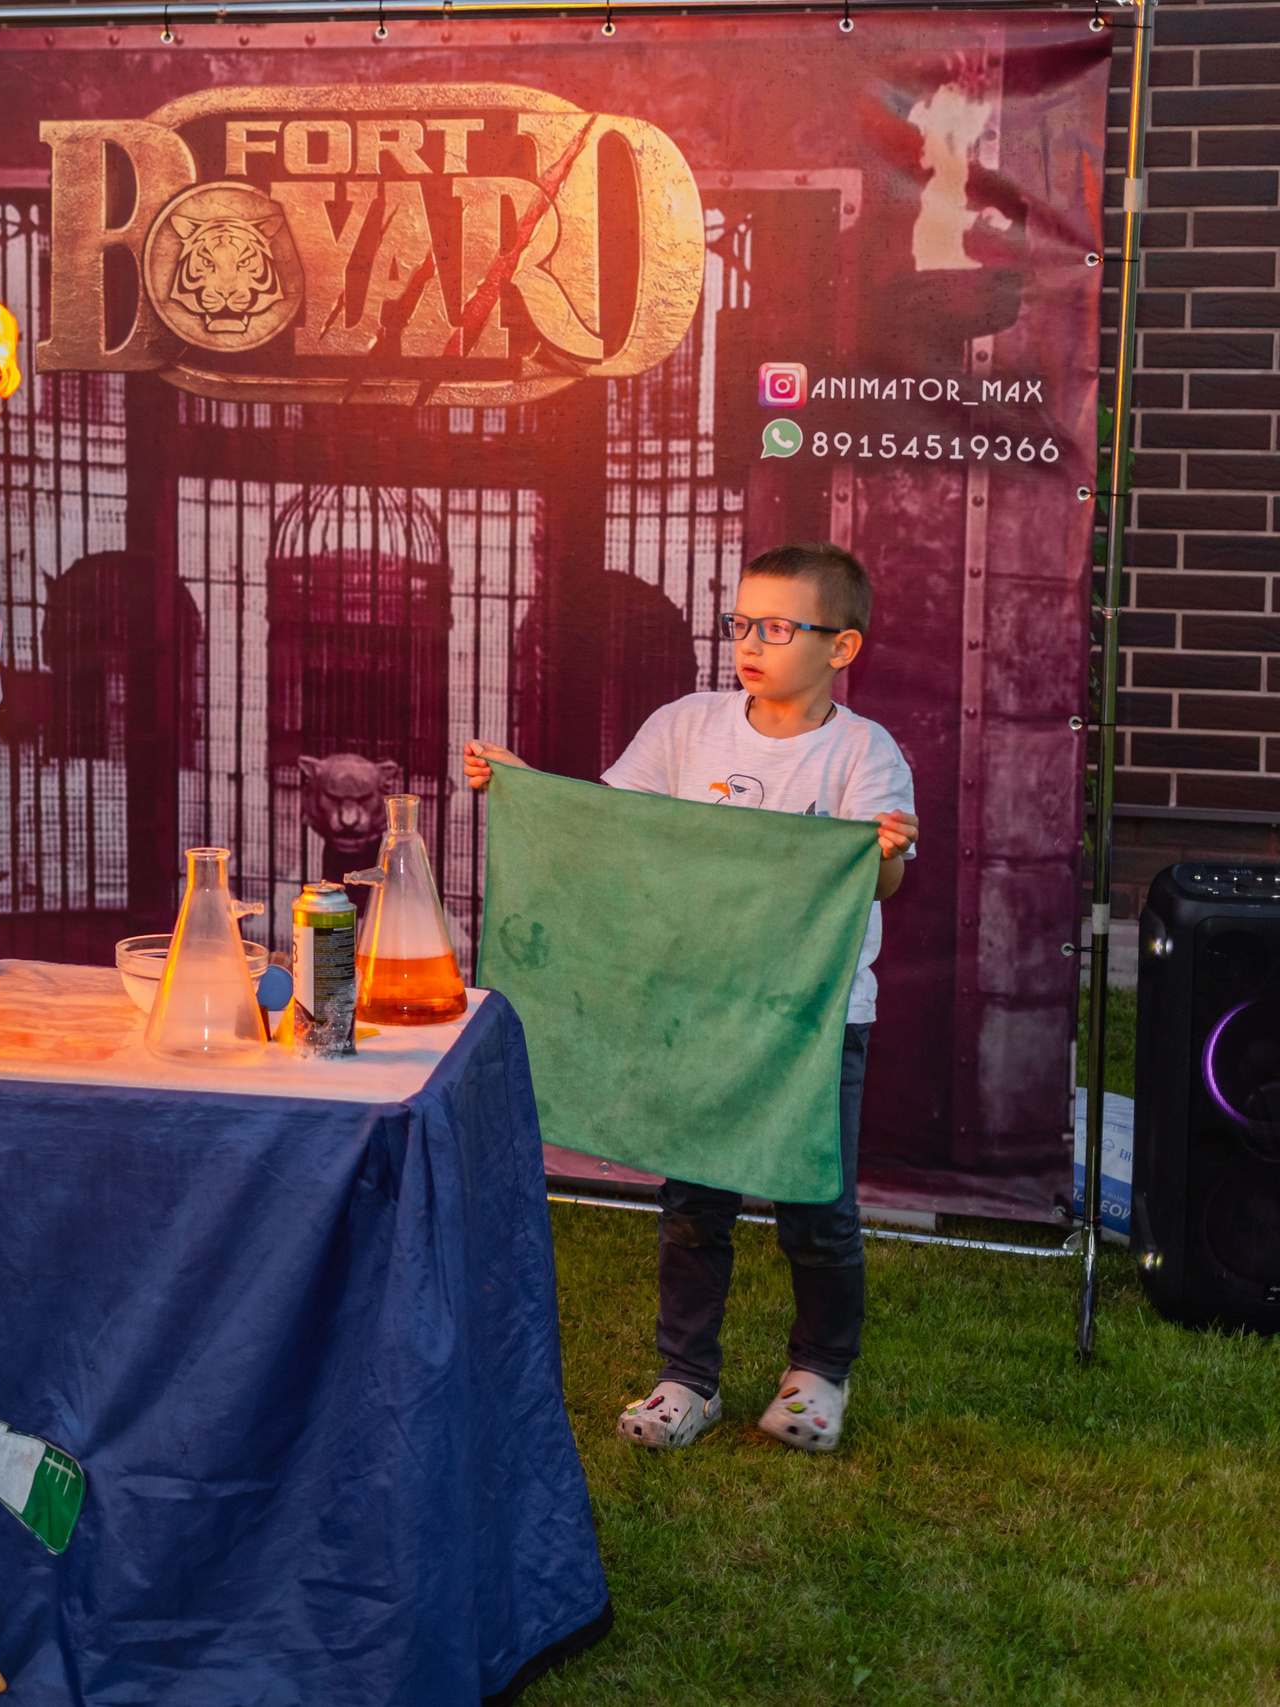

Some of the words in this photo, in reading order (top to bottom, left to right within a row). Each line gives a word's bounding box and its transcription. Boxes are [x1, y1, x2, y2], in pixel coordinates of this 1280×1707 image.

[224, 118, 484, 175] FORT
[811, 377, 1043, 406] ANIMATOR_MAX
[812, 431, 1060, 463] 89154519366
